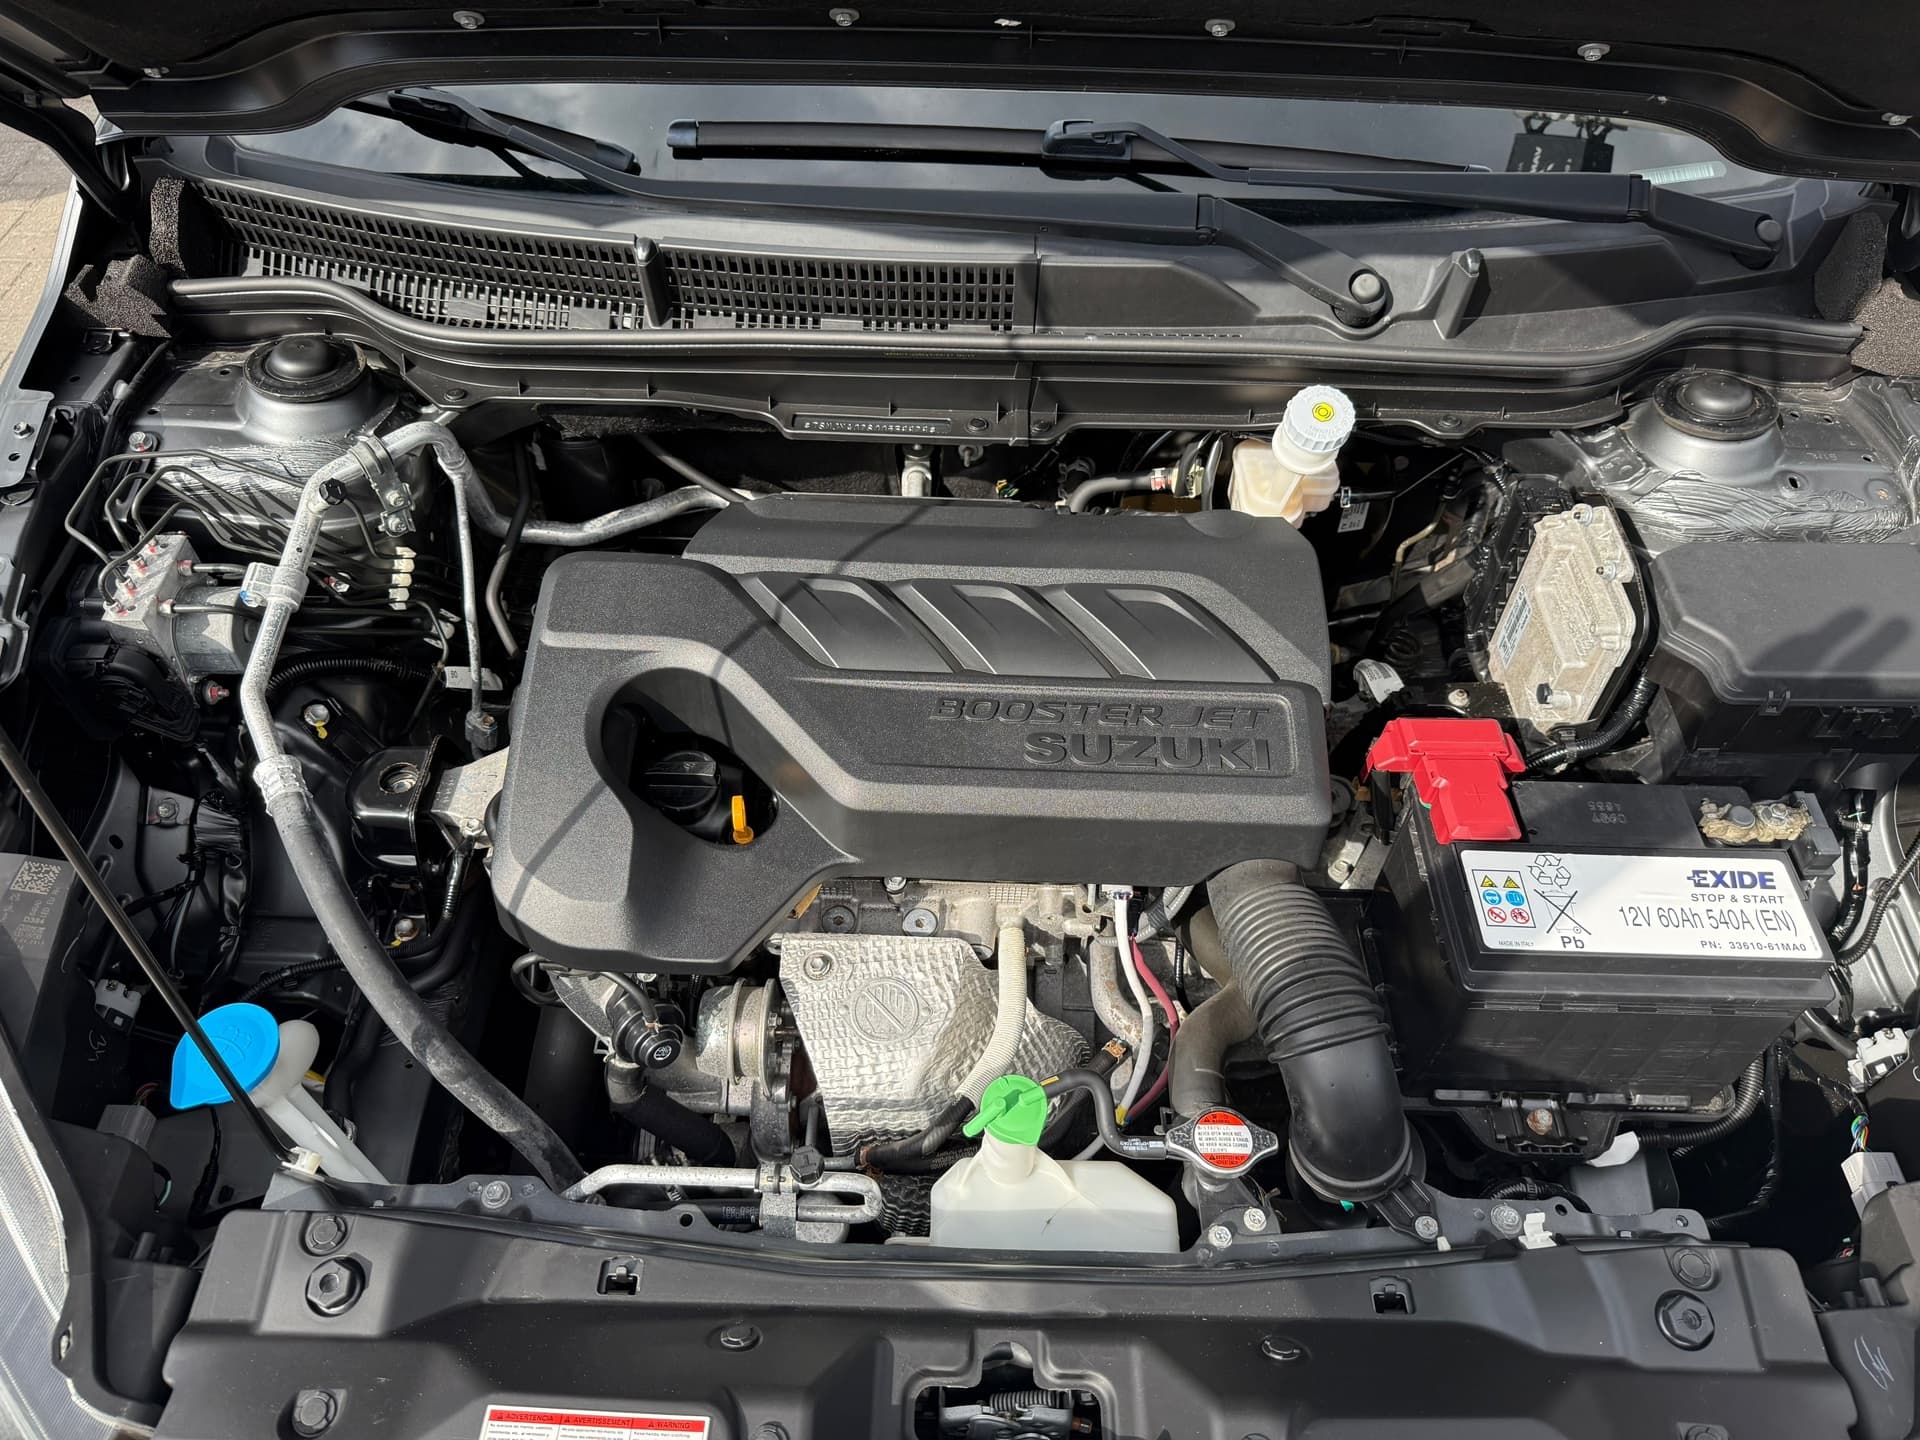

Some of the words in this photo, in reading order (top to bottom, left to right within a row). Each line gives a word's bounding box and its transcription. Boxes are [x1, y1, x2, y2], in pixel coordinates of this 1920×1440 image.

[929, 698, 1164, 728] BOOSTER
[1170, 704, 1271, 731] JET
[1023, 731, 1272, 771] SUZUKI
[1686, 869, 1777, 890] EXIDE
[1690, 893, 1726, 903] STOP
[1730, 894, 1739, 903] &
[1743, 894, 1785, 905] START
[1618, 905, 1652, 928] 12V
[1656, 906, 1704, 929] 60Ah
[1705, 908, 1756, 930] 540A
[1755, 908, 1798, 937] (EN)
[1560, 935, 1586, 950] Pb
[1700, 940, 1723, 950] PN:
[1728, 941, 1807, 952] 33610-61MA0
[656, 1421, 691, 1429] WARNING
